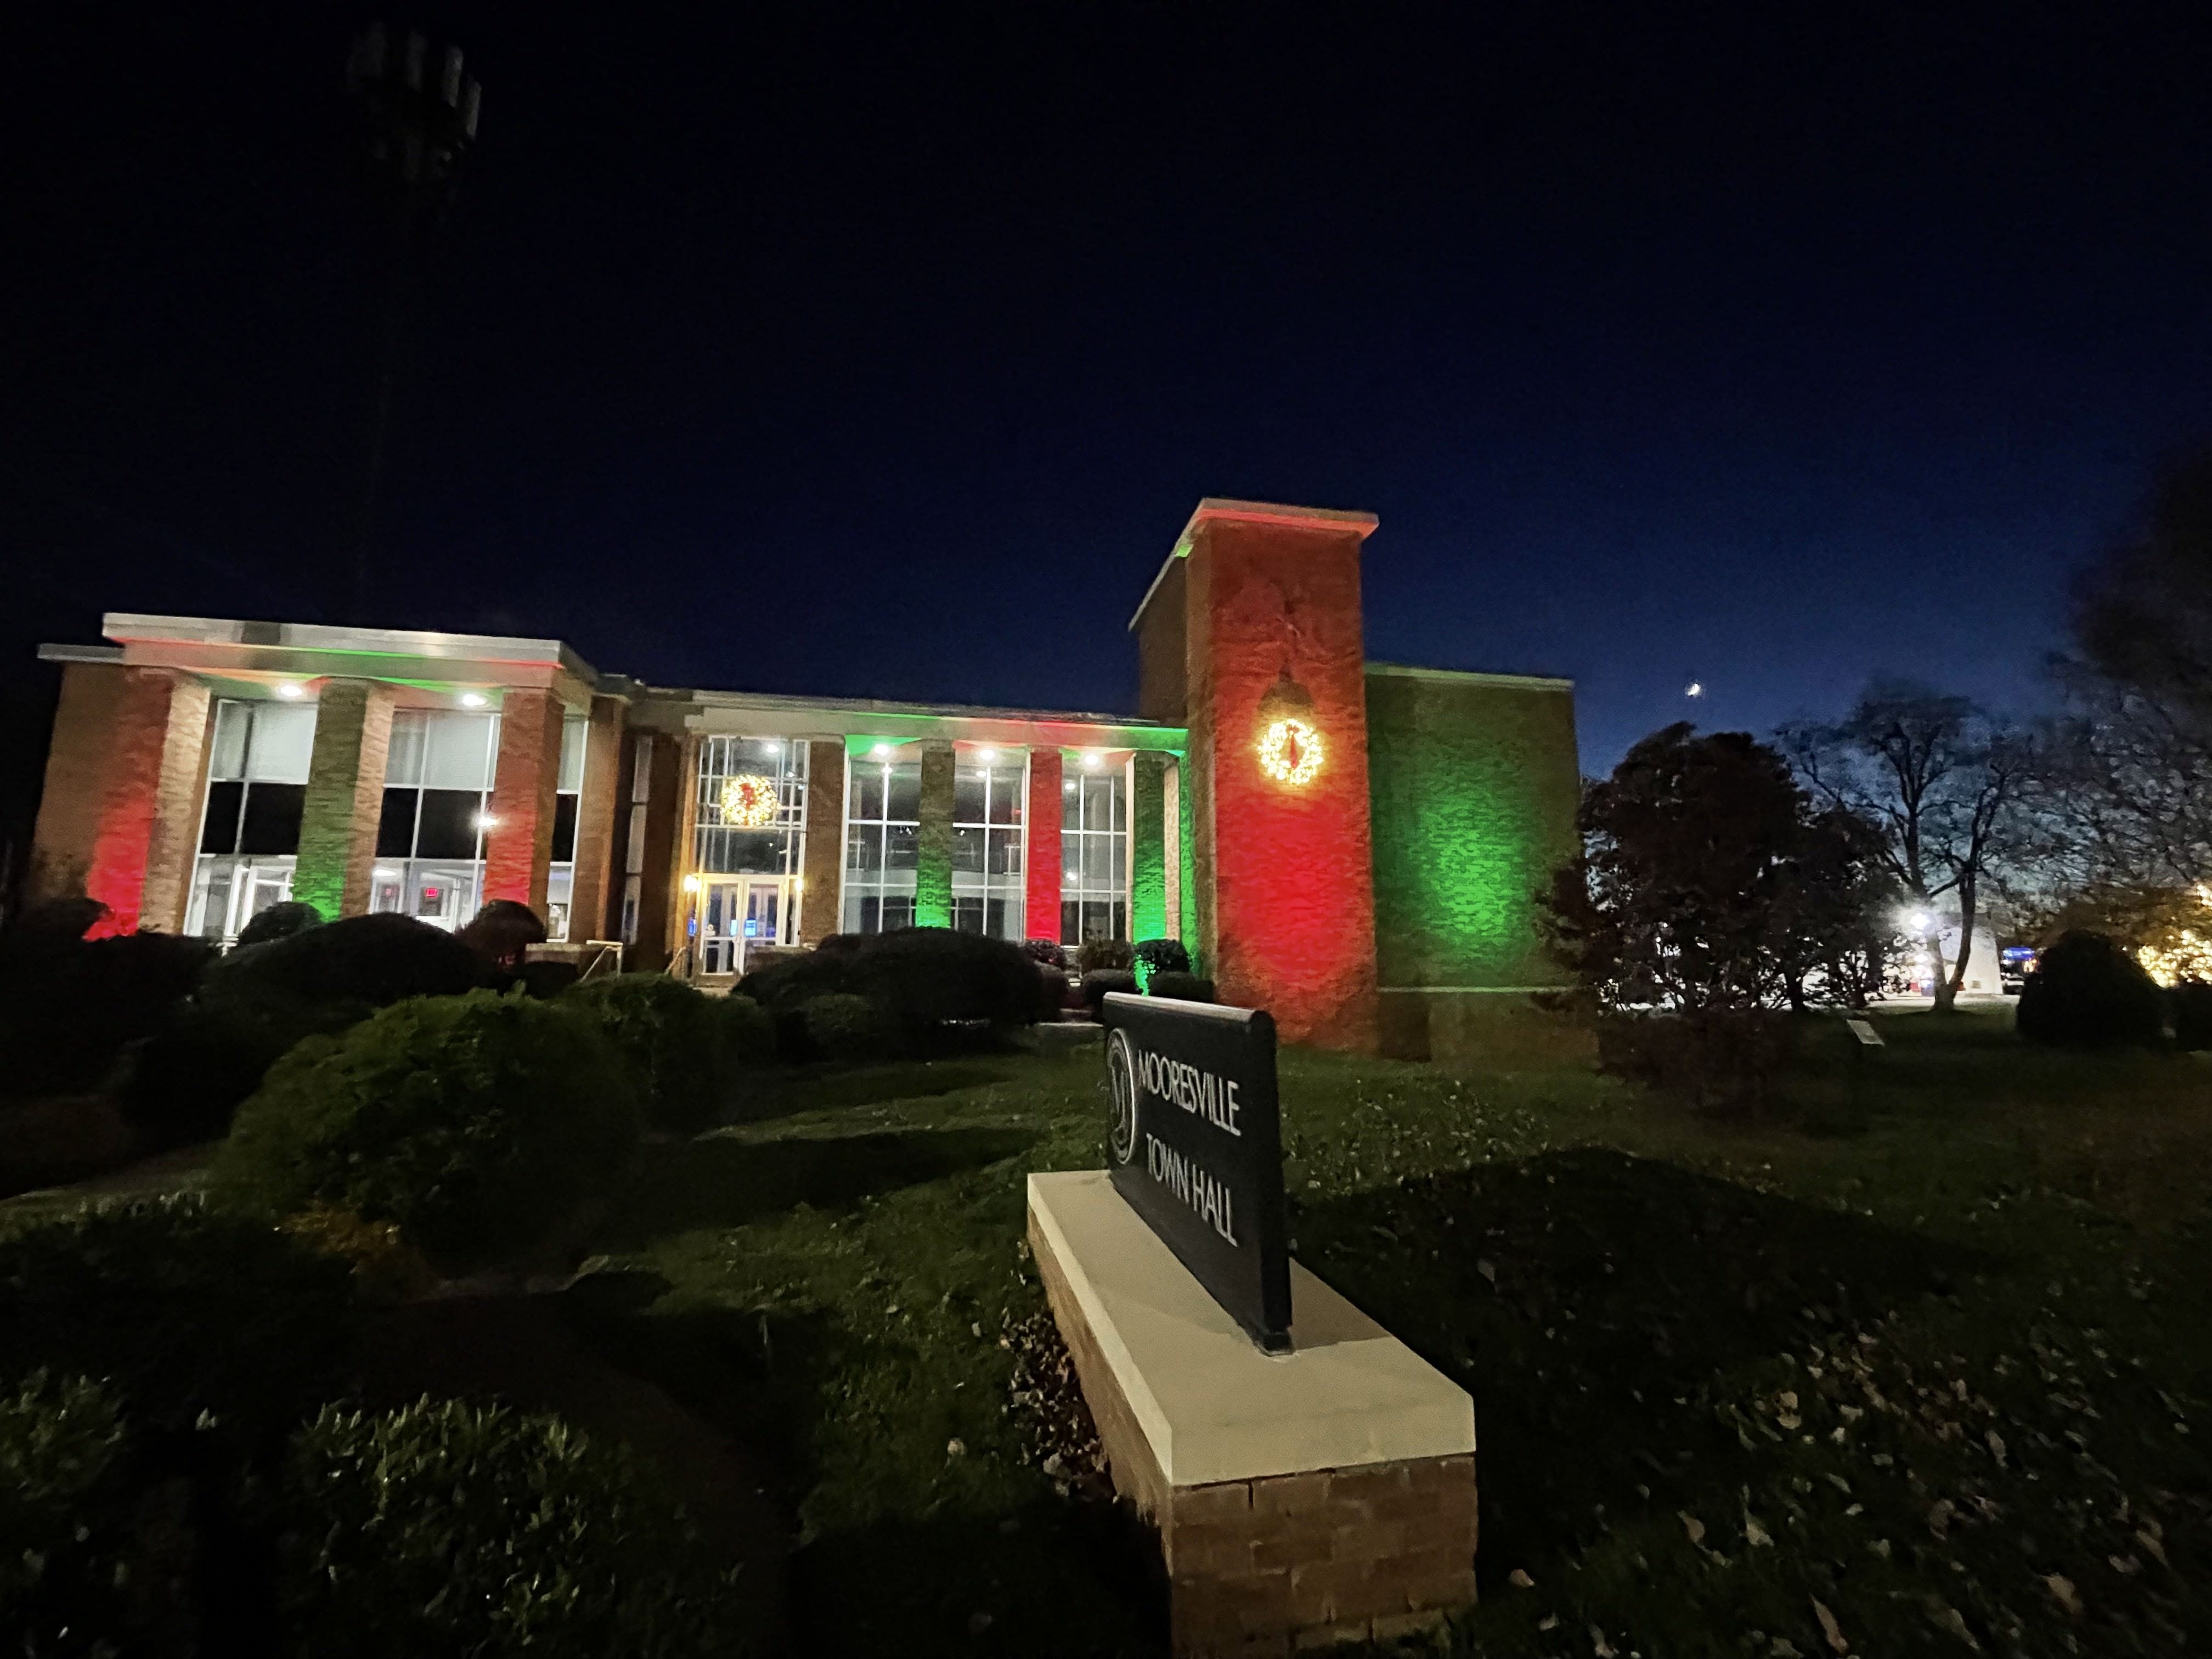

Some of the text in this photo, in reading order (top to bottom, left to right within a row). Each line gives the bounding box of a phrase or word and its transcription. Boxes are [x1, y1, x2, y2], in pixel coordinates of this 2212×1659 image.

[1138, 1049, 1242, 1136] MOORESVILLE
[1146, 1132, 1238, 1247] TOWN HALL
